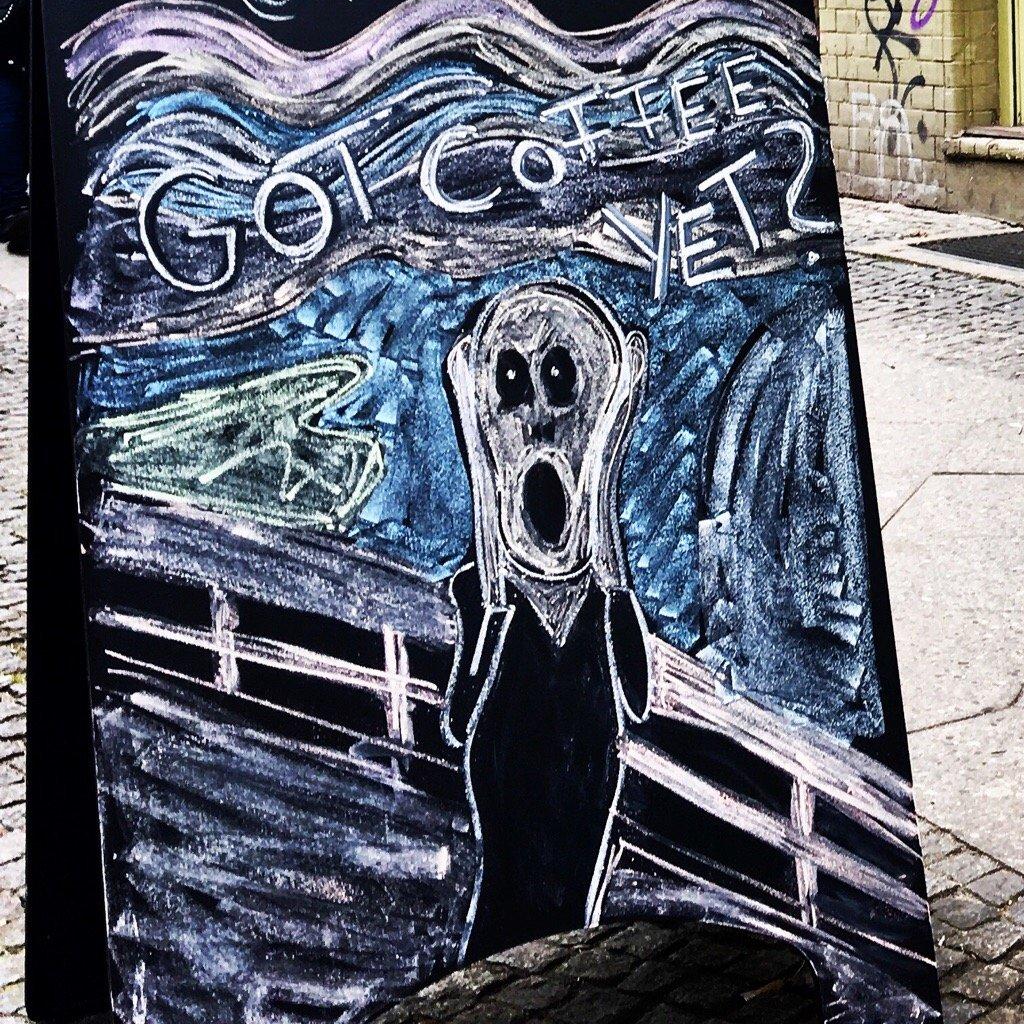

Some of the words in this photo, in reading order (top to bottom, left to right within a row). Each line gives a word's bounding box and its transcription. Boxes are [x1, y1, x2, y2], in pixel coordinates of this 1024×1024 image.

[138, 107, 394, 292] GOT
[420, 54, 768, 213] COFFEE
[602, 118, 841, 300] YET?
